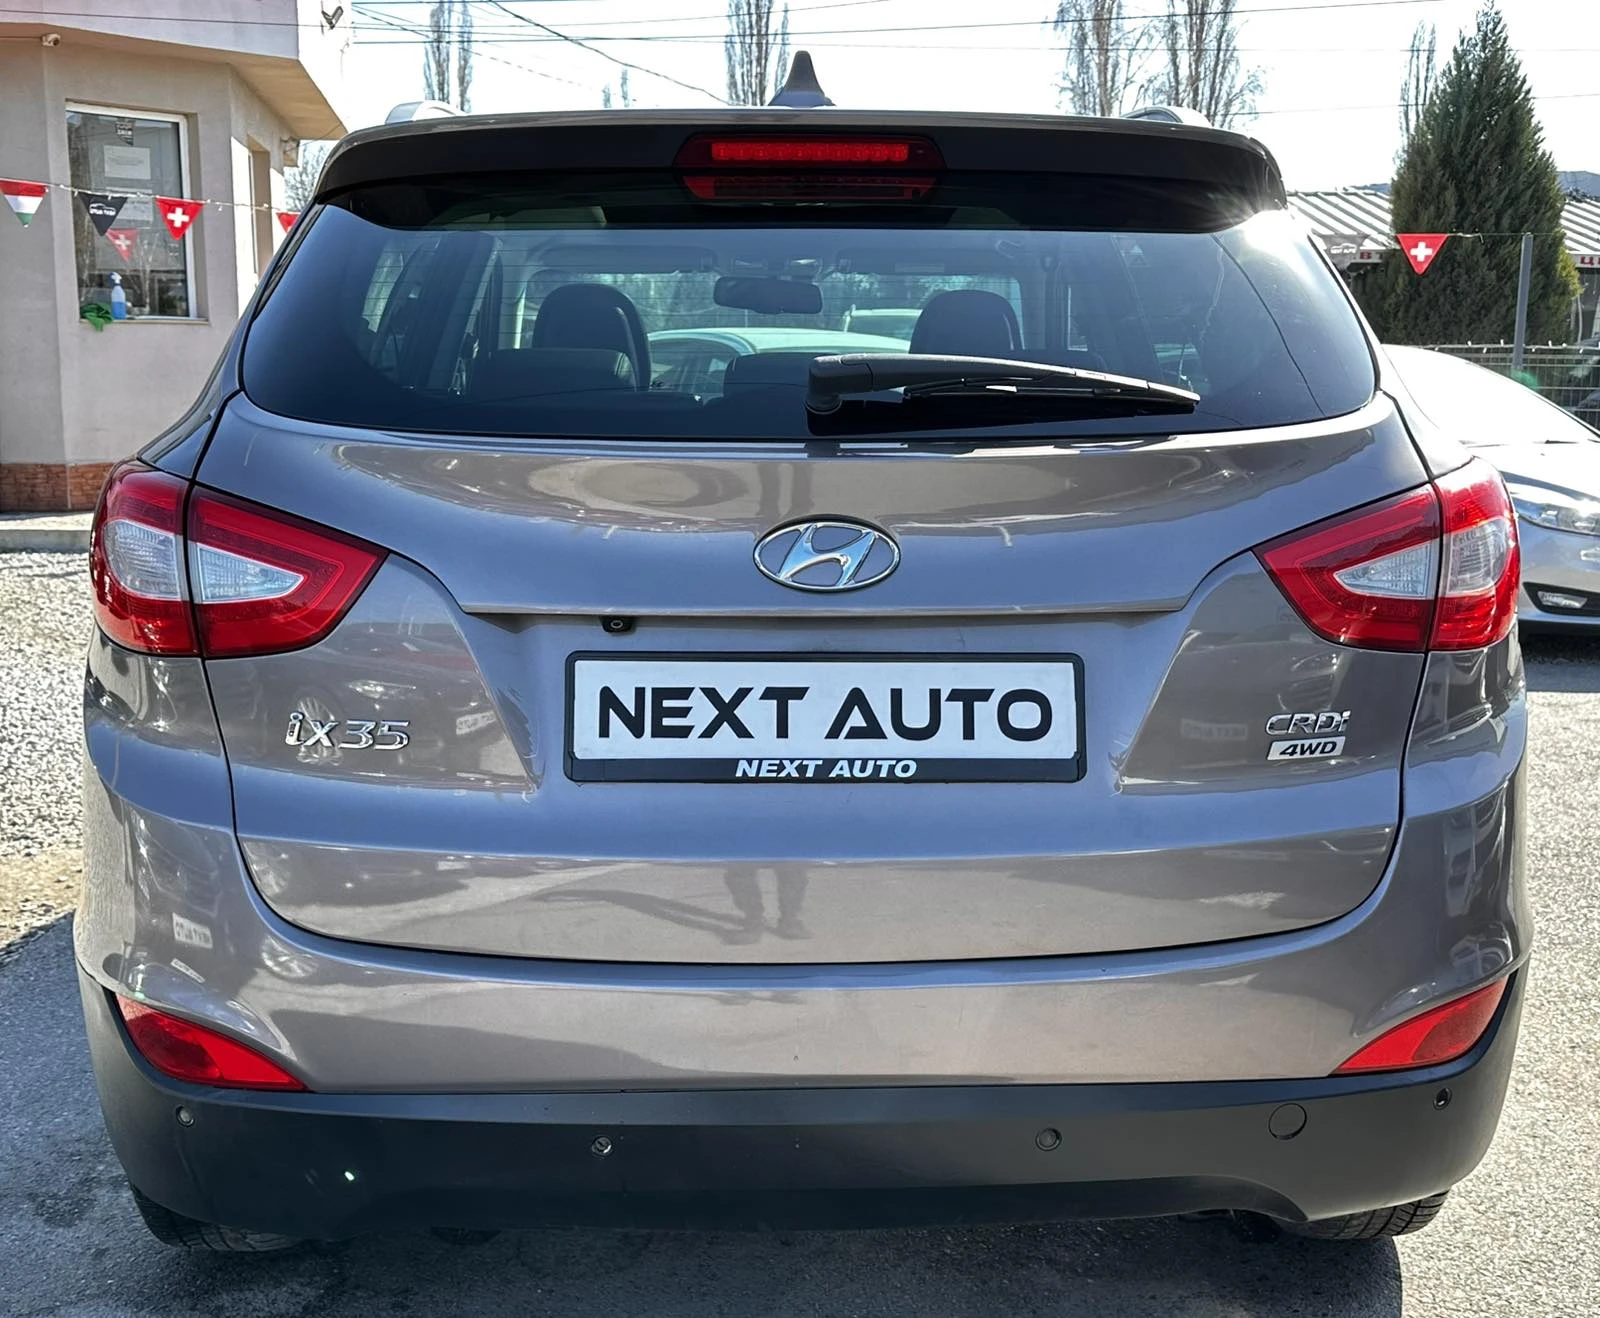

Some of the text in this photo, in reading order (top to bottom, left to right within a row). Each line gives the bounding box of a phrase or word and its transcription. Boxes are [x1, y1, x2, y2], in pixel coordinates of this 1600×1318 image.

[599, 686, 1053, 741] NEXT AUTO
[1265, 710, 1351, 735] CRDi
[285, 712, 410, 750] ix35
[1279, 741, 1337, 757] 4WD
[735, 759, 918, 778] NEXT AUTO
